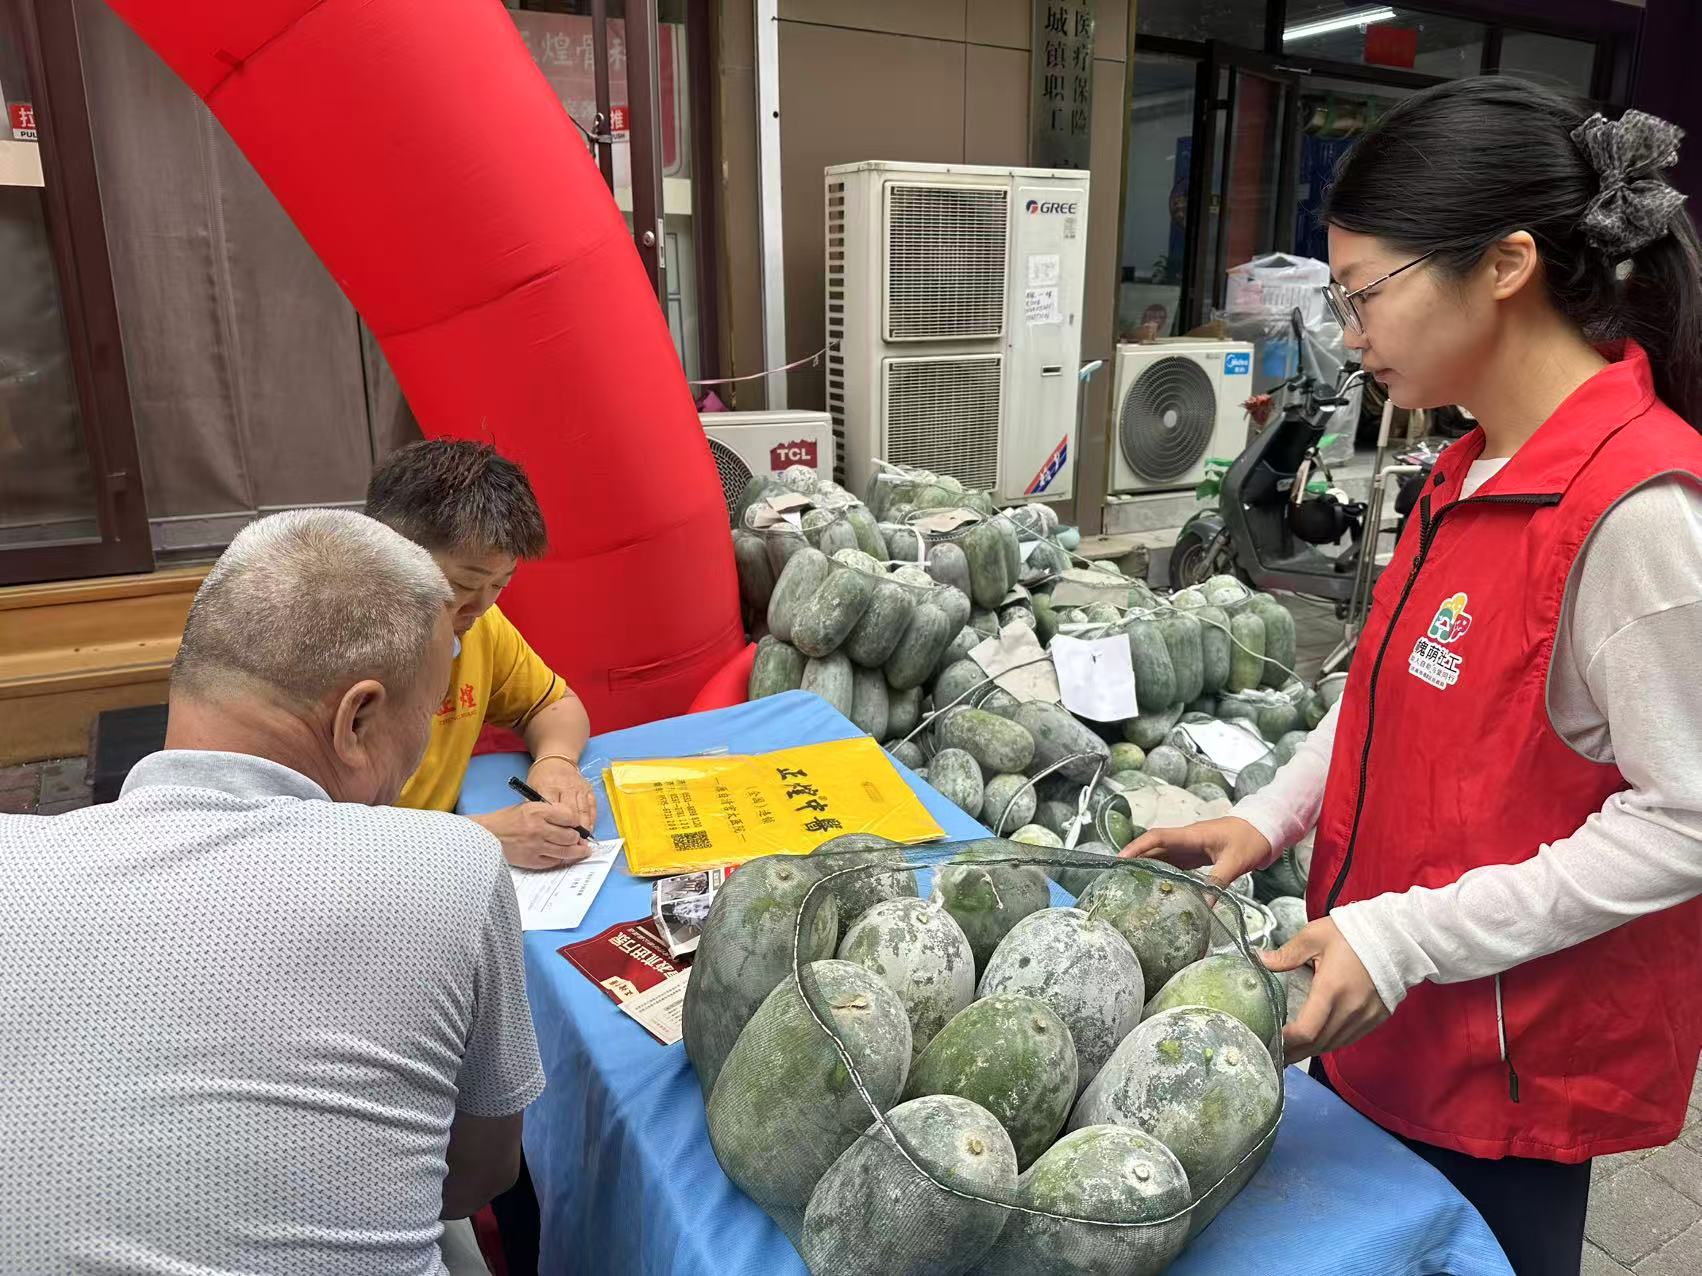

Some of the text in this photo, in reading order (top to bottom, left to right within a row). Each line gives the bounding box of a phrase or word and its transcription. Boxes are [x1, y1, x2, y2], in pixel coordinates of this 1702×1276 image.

[1043, 0, 1068, 132] 城镇职工
[1072, 0, 1090, 136] 医疗保险
[18, 107, 36, 127] 拉
[610, 109, 624, 130] 推
[1040, 202, 1078, 214] GREE
[776, 448, 812, 461] TCL
[1414, 639, 1460, 673] 槐荫社工
